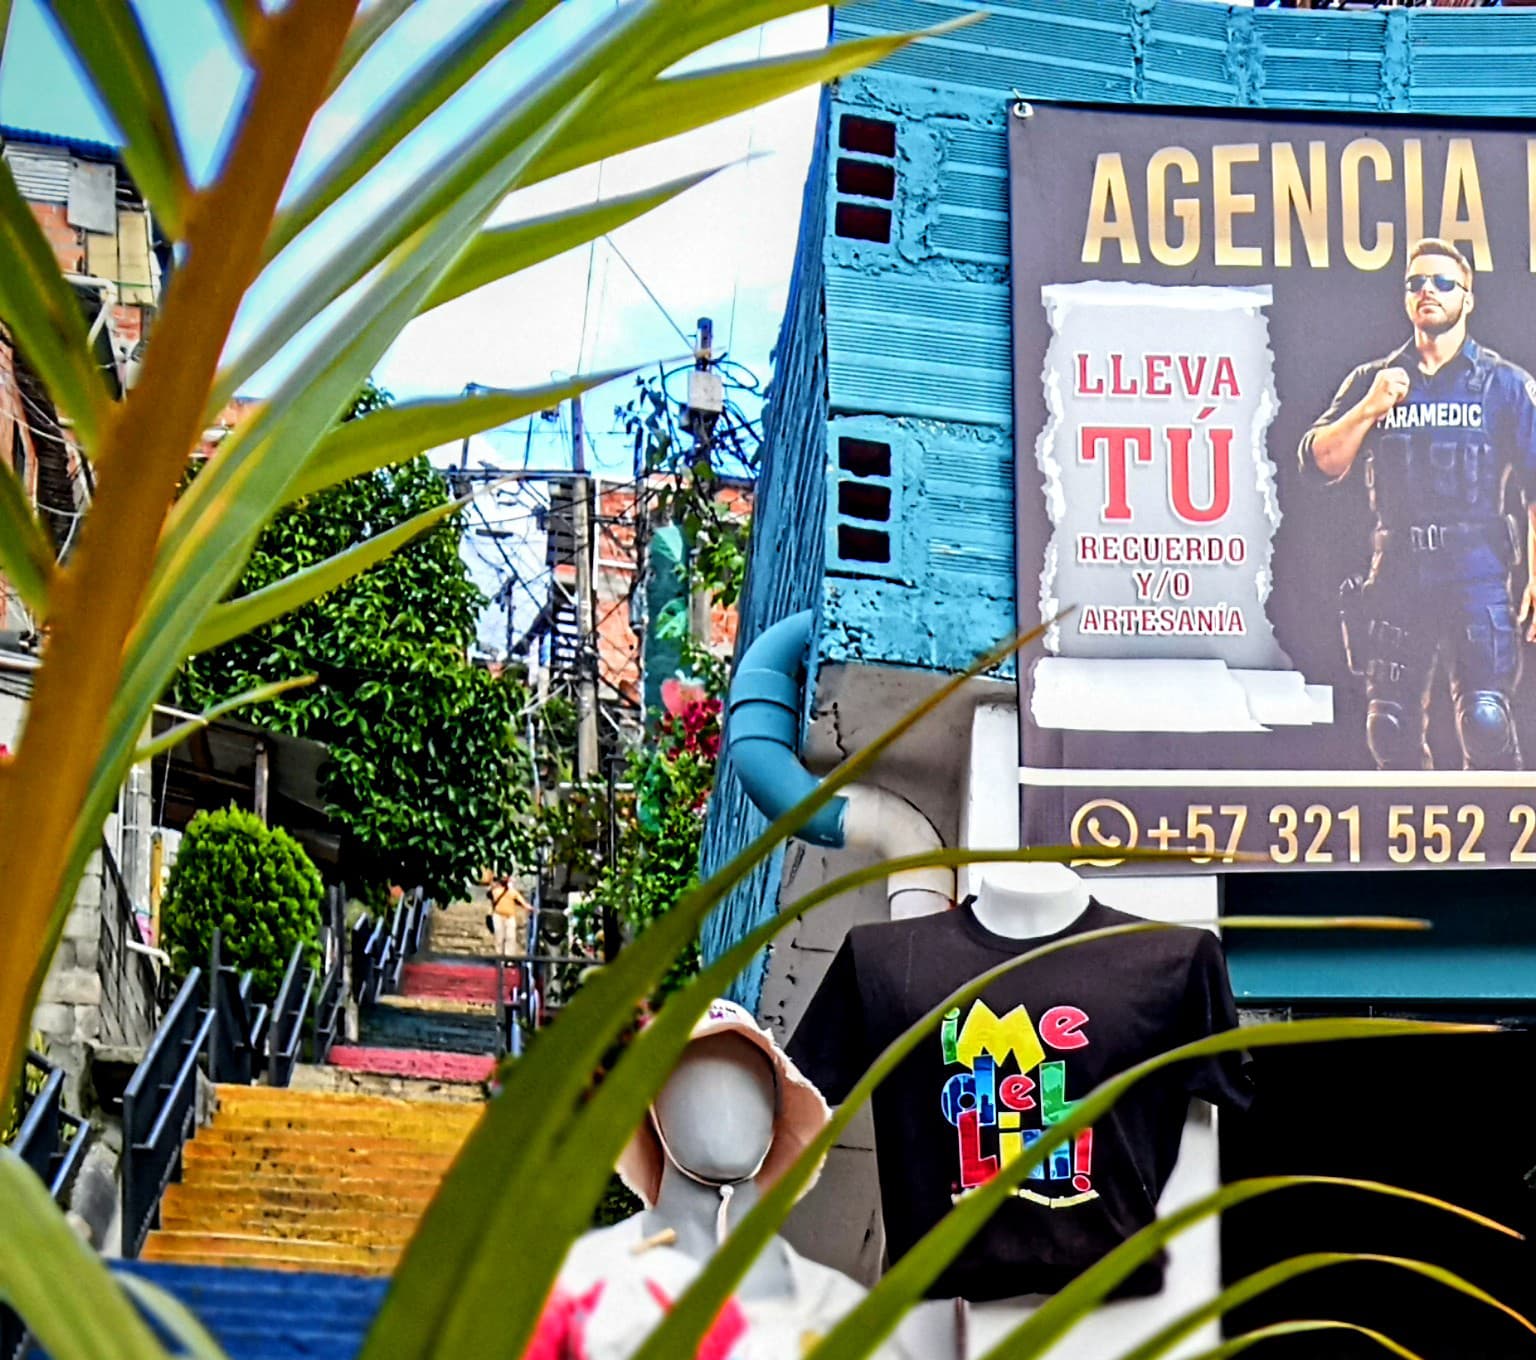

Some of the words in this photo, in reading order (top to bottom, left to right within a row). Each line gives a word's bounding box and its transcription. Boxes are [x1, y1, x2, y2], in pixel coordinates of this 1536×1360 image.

[1081, 138, 1494, 273] AGENCIA
[1077, 353, 1241, 396] LLEVA
[1377, 403, 1482, 428] ARAMEDIC
[1081, 406, 1234, 522] TÚ
[1080, 535, 1245, 562] RECUERDO
[1136, 570, 1190, 599] Y/O
[1083, 603, 1244, 633] ARTESANÍA
[1147, 804, 1249, 865] +57
[1269, 804, 1362, 864] 321
[1387, 804, 1486, 864] 552
